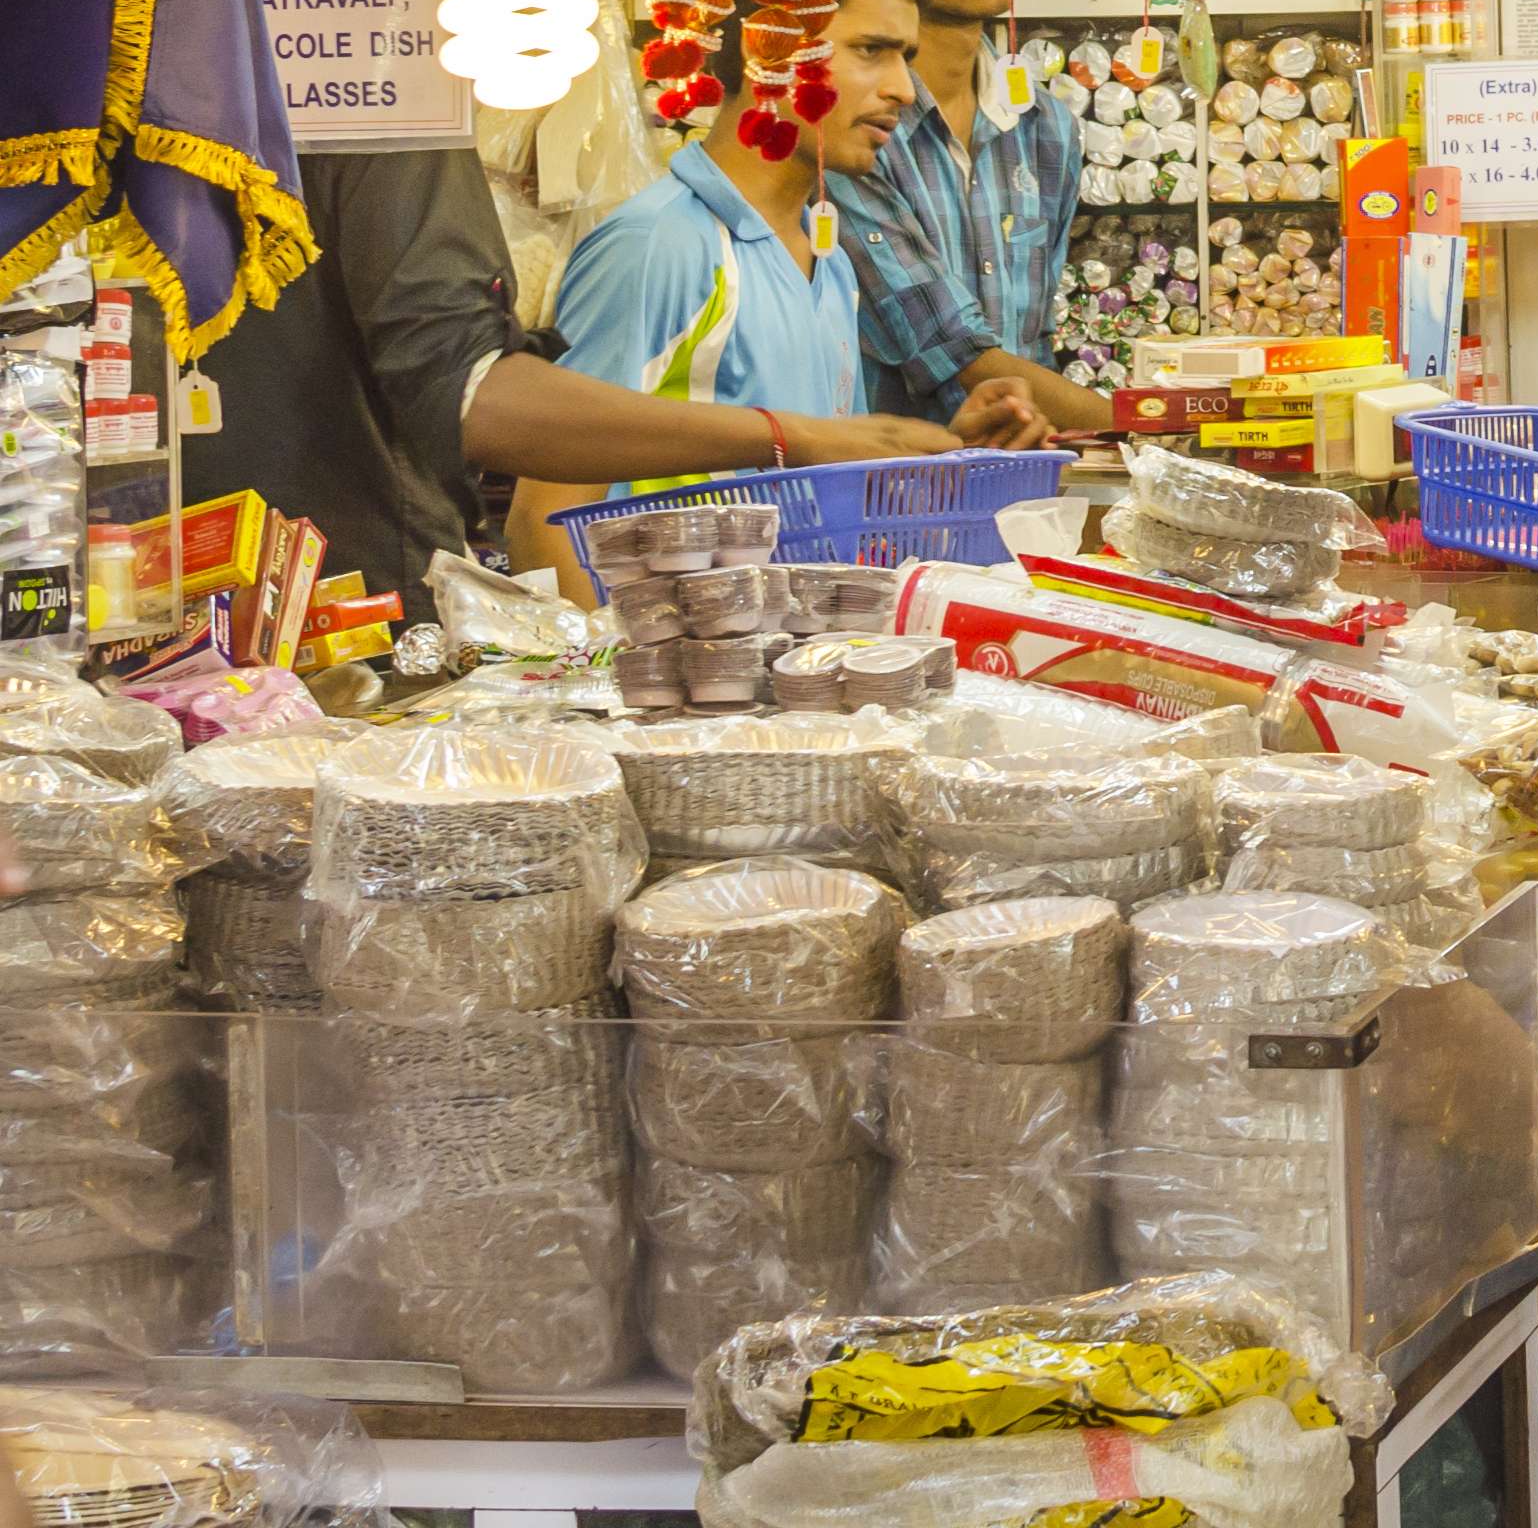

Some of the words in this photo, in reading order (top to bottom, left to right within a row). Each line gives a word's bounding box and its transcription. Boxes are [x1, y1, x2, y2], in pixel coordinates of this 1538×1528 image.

[274, 32, 353, 59] COLE
[369, 30, 434, 57] DISH
[286, 80, 397, 108] LASSES
[1479, 77, 1538, 98] (Extra)
[1446, 113, 1485, 125] PRICE
[1506, 112, 1525, 124] PC.
[1441, 139, 1460, 155] 10
[1482, 138, 1500, 154] 14
[1484, 168, 1504, 183] 16
[1184, 396, 1229, 414] ECO
[1281, 400, 1313, 413] TIRTH
[1237, 431, 1269, 442] TIRTH
[8, 586, 68, 612] HILTON
[102, 611, 199, 665] SRADHA
